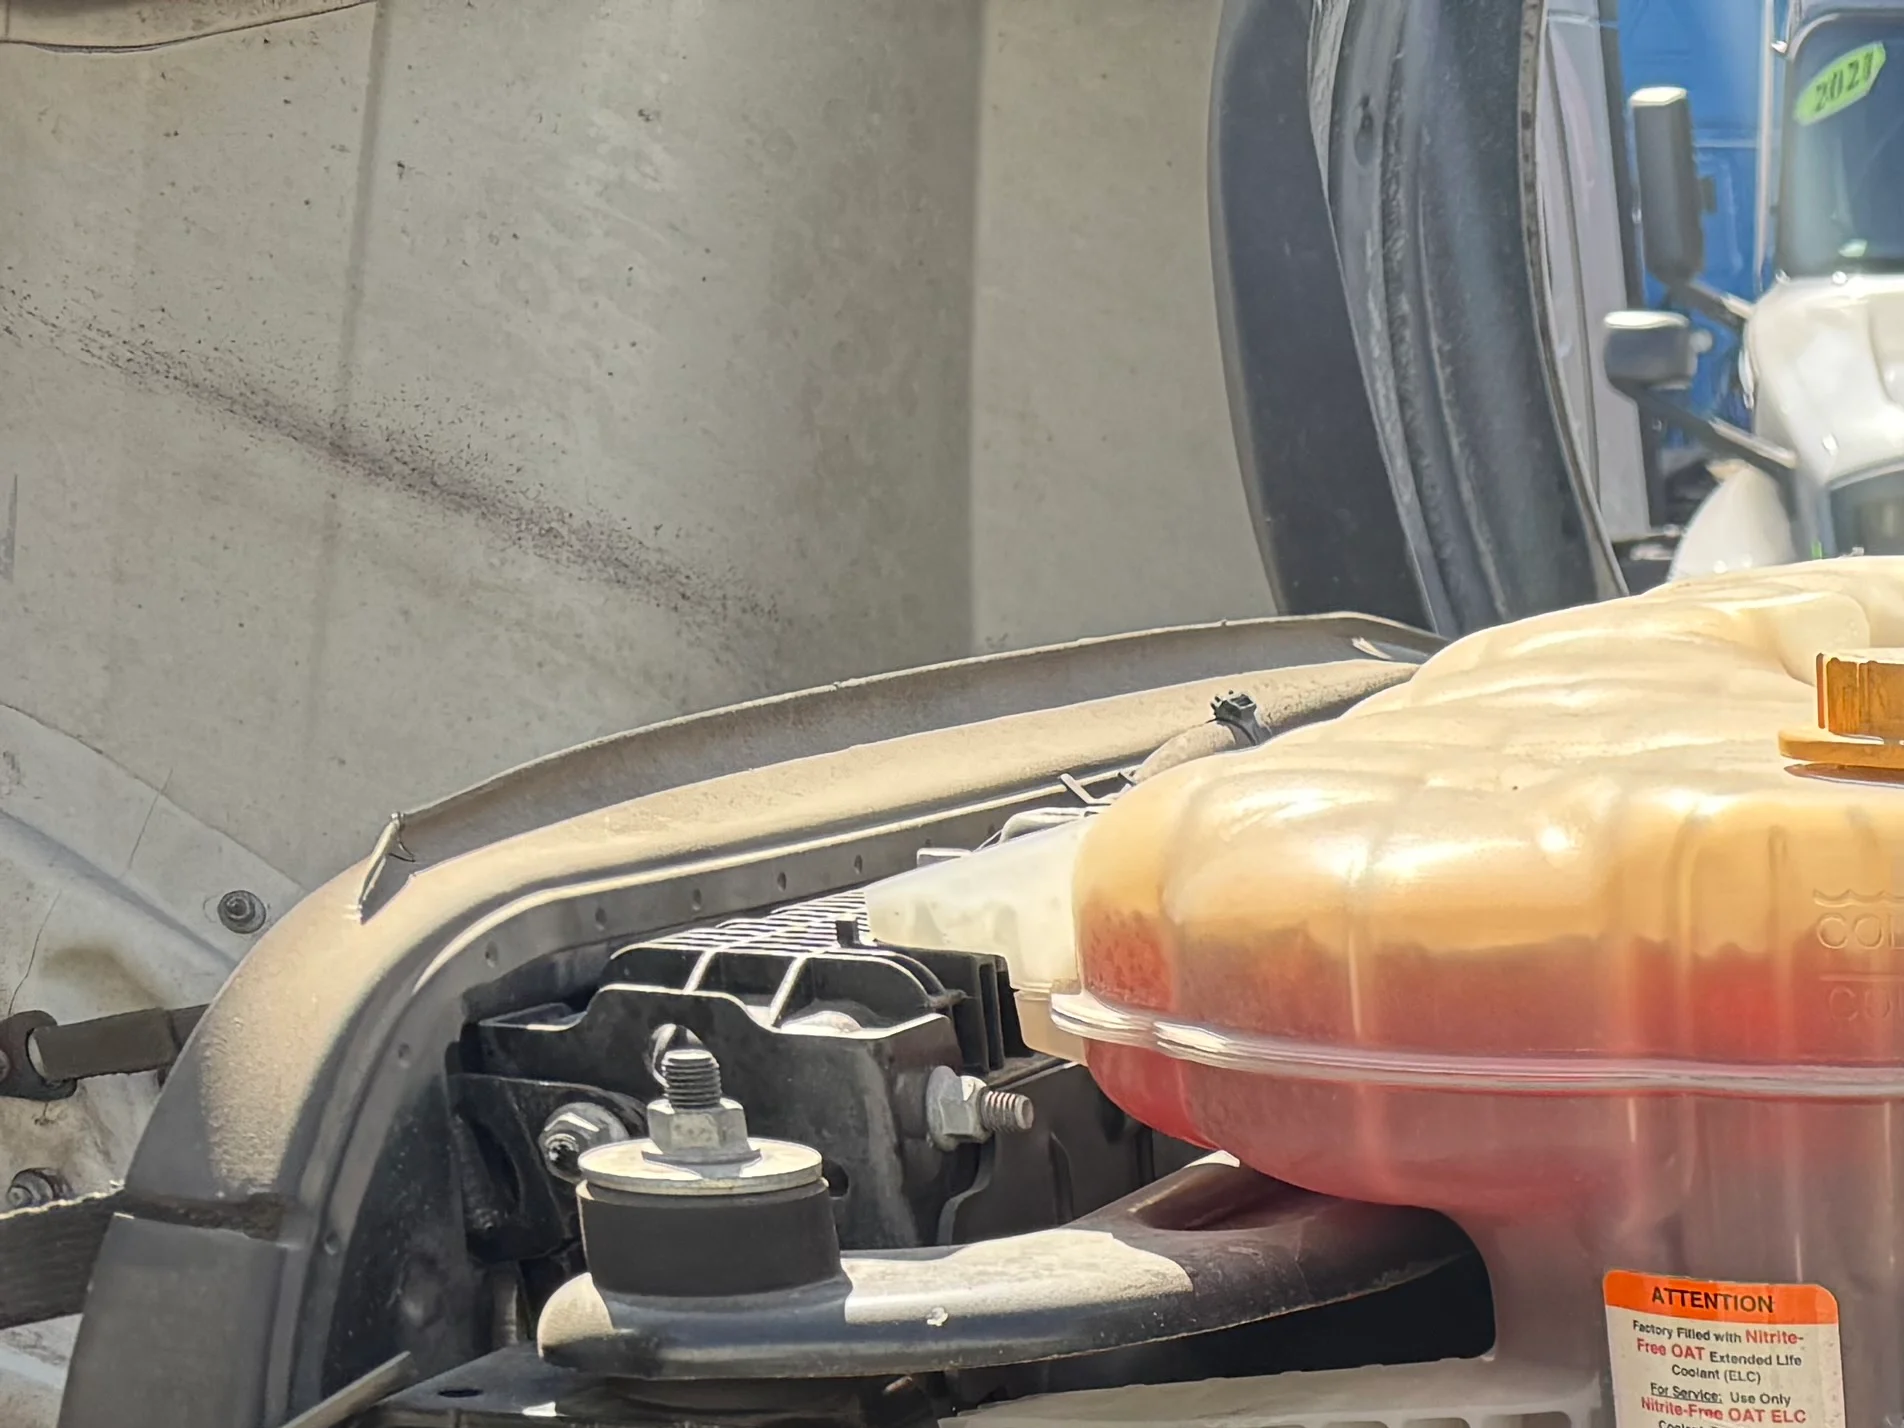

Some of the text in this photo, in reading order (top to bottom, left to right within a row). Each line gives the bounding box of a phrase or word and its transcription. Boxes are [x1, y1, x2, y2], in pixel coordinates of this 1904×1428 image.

[1652, 1286, 1773, 1312] ATTENTION
[1633, 1320, 1804, 1344] Factory Filled with Nitrite-
[1637, 1339, 1801, 1366] Free OAT Extended Life
[1672, 1365, 1761, 1385] Coolant (ELC)
[1650, 1383, 1791, 1407] For Service: Use Only
[1641, 1397, 1806, 1423] Nitrite-Free OAT ELC
